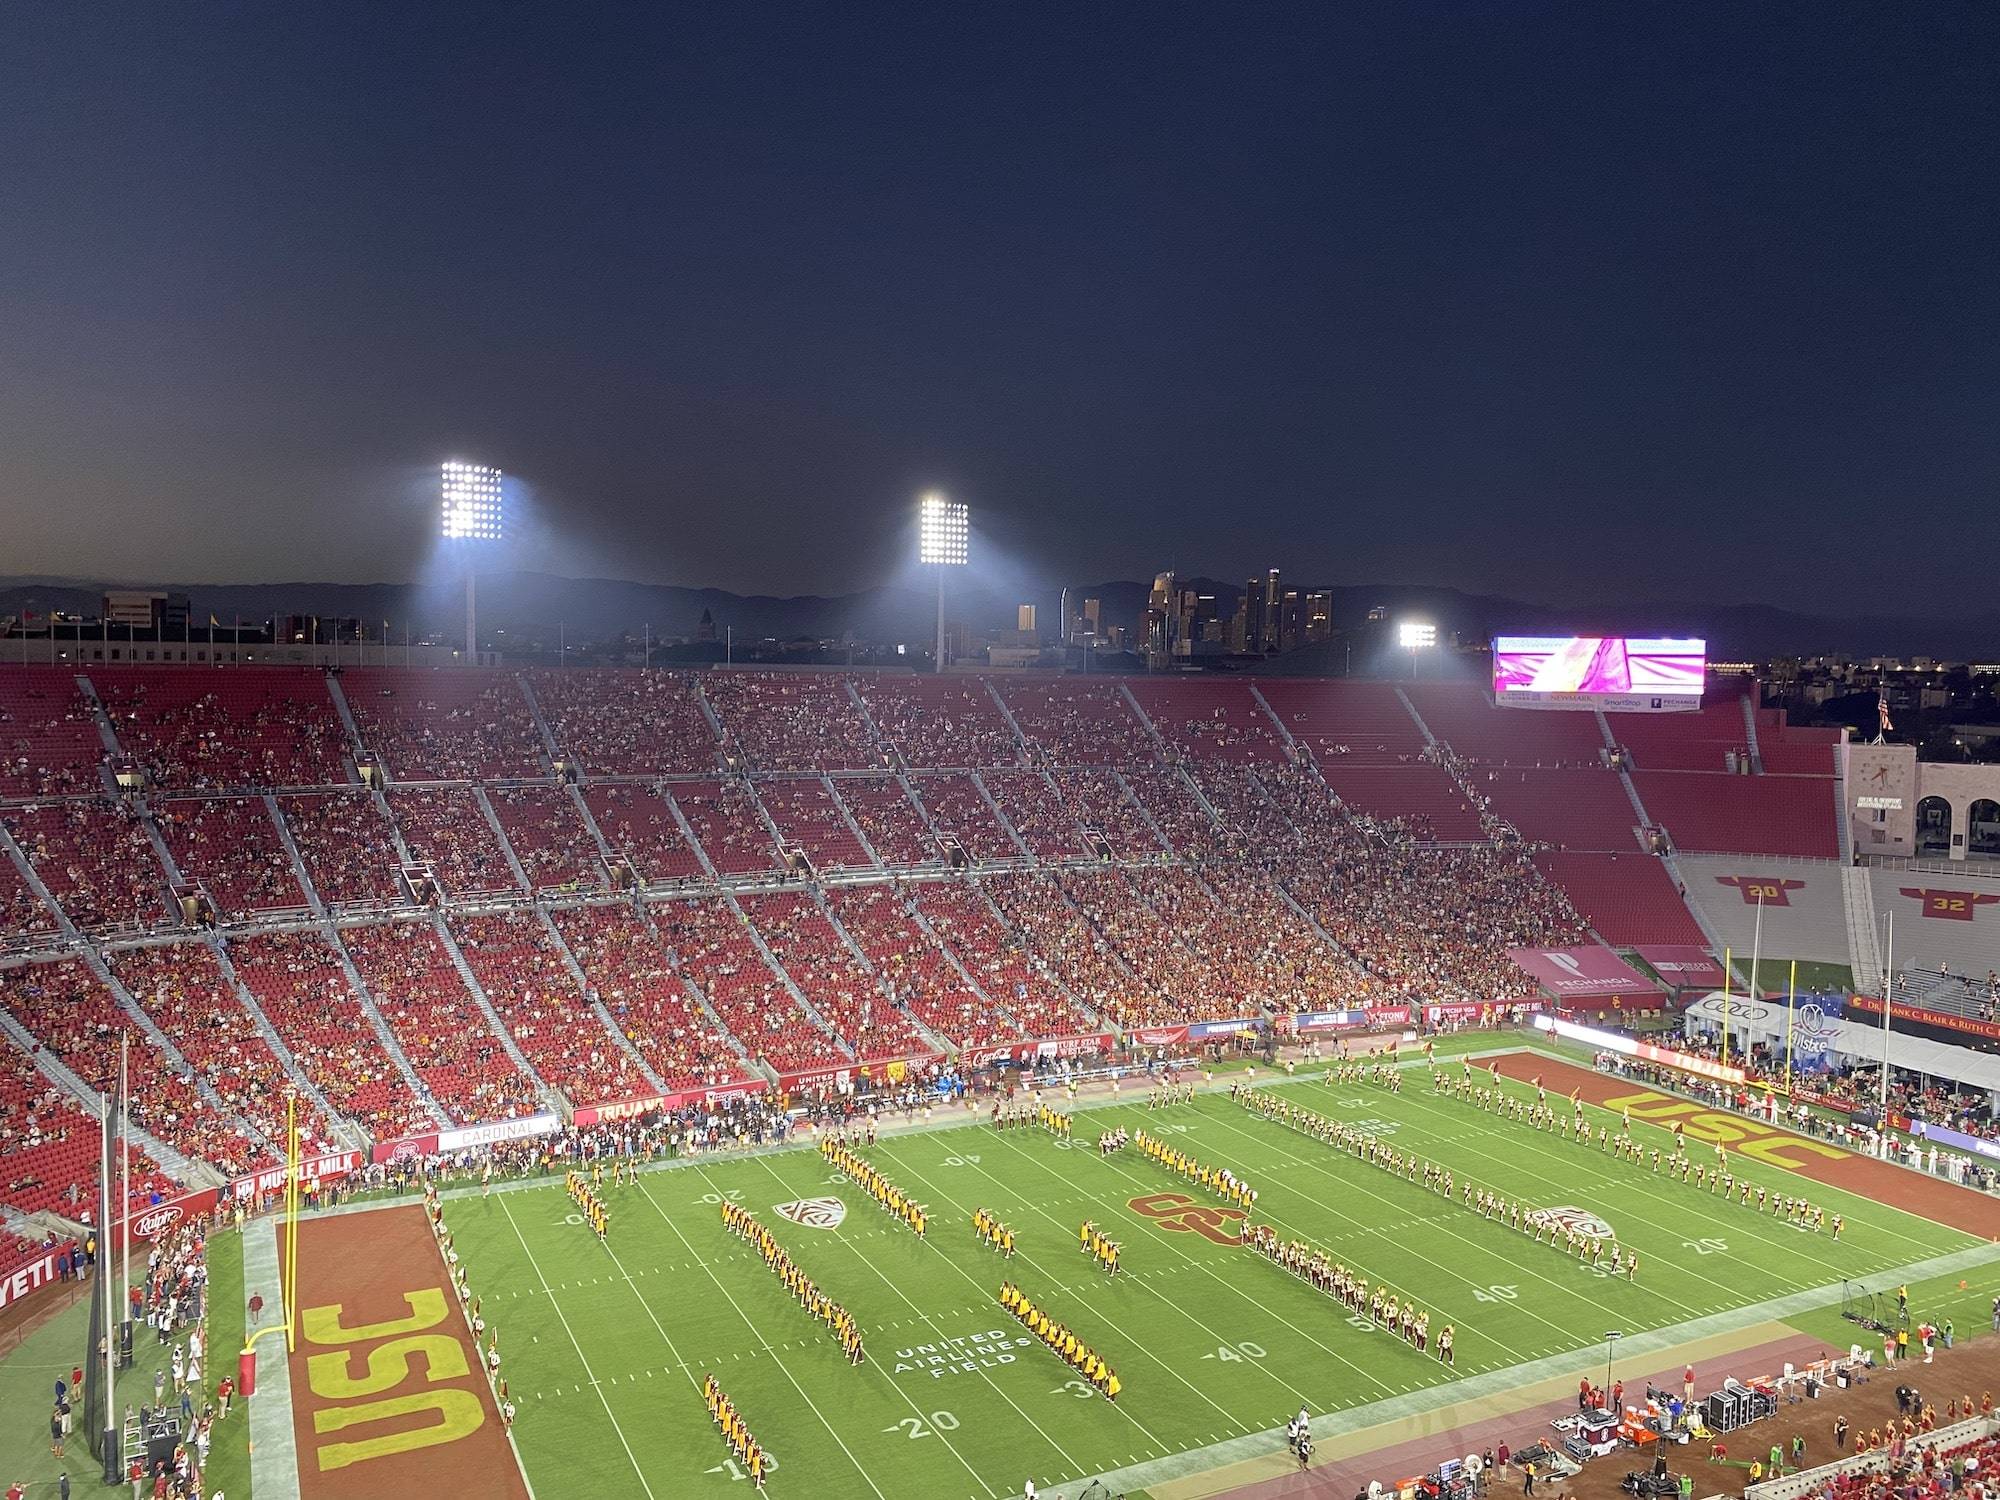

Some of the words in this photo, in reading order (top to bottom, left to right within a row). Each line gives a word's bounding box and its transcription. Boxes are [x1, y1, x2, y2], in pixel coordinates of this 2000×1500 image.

[1747, 885, 1778, 897] 20
[1932, 898, 1965, 911] 32
[1923, 1013, 1947, 1025] BLAIR
[1949, 1019, 1957, 1027] &
[1959, 1020, 1983, 1033] RUTH
[798, 1073, 834, 1085] UNITED
[462, 1122, 534, 1144] CARDINAL
[1603, 1092, 1851, 1169] USC
[318, 1153, 354, 1176] MILK
[1682, 1237, 1728, 1255] 20
[0, 1254, 54, 1308] YETI
[1472, 1285, 1518, 1303] 40
[896, 1330, 1007, 1358] UNITED
[1217, 1341, 1267, 1363] 40
[894, 1337, 1032, 1374] AIRLINES
[929, 1354, 1017, 1379] FIELD
[302, 1287, 485, 1472] USC
[899, 1410, 961, 1440] 20
